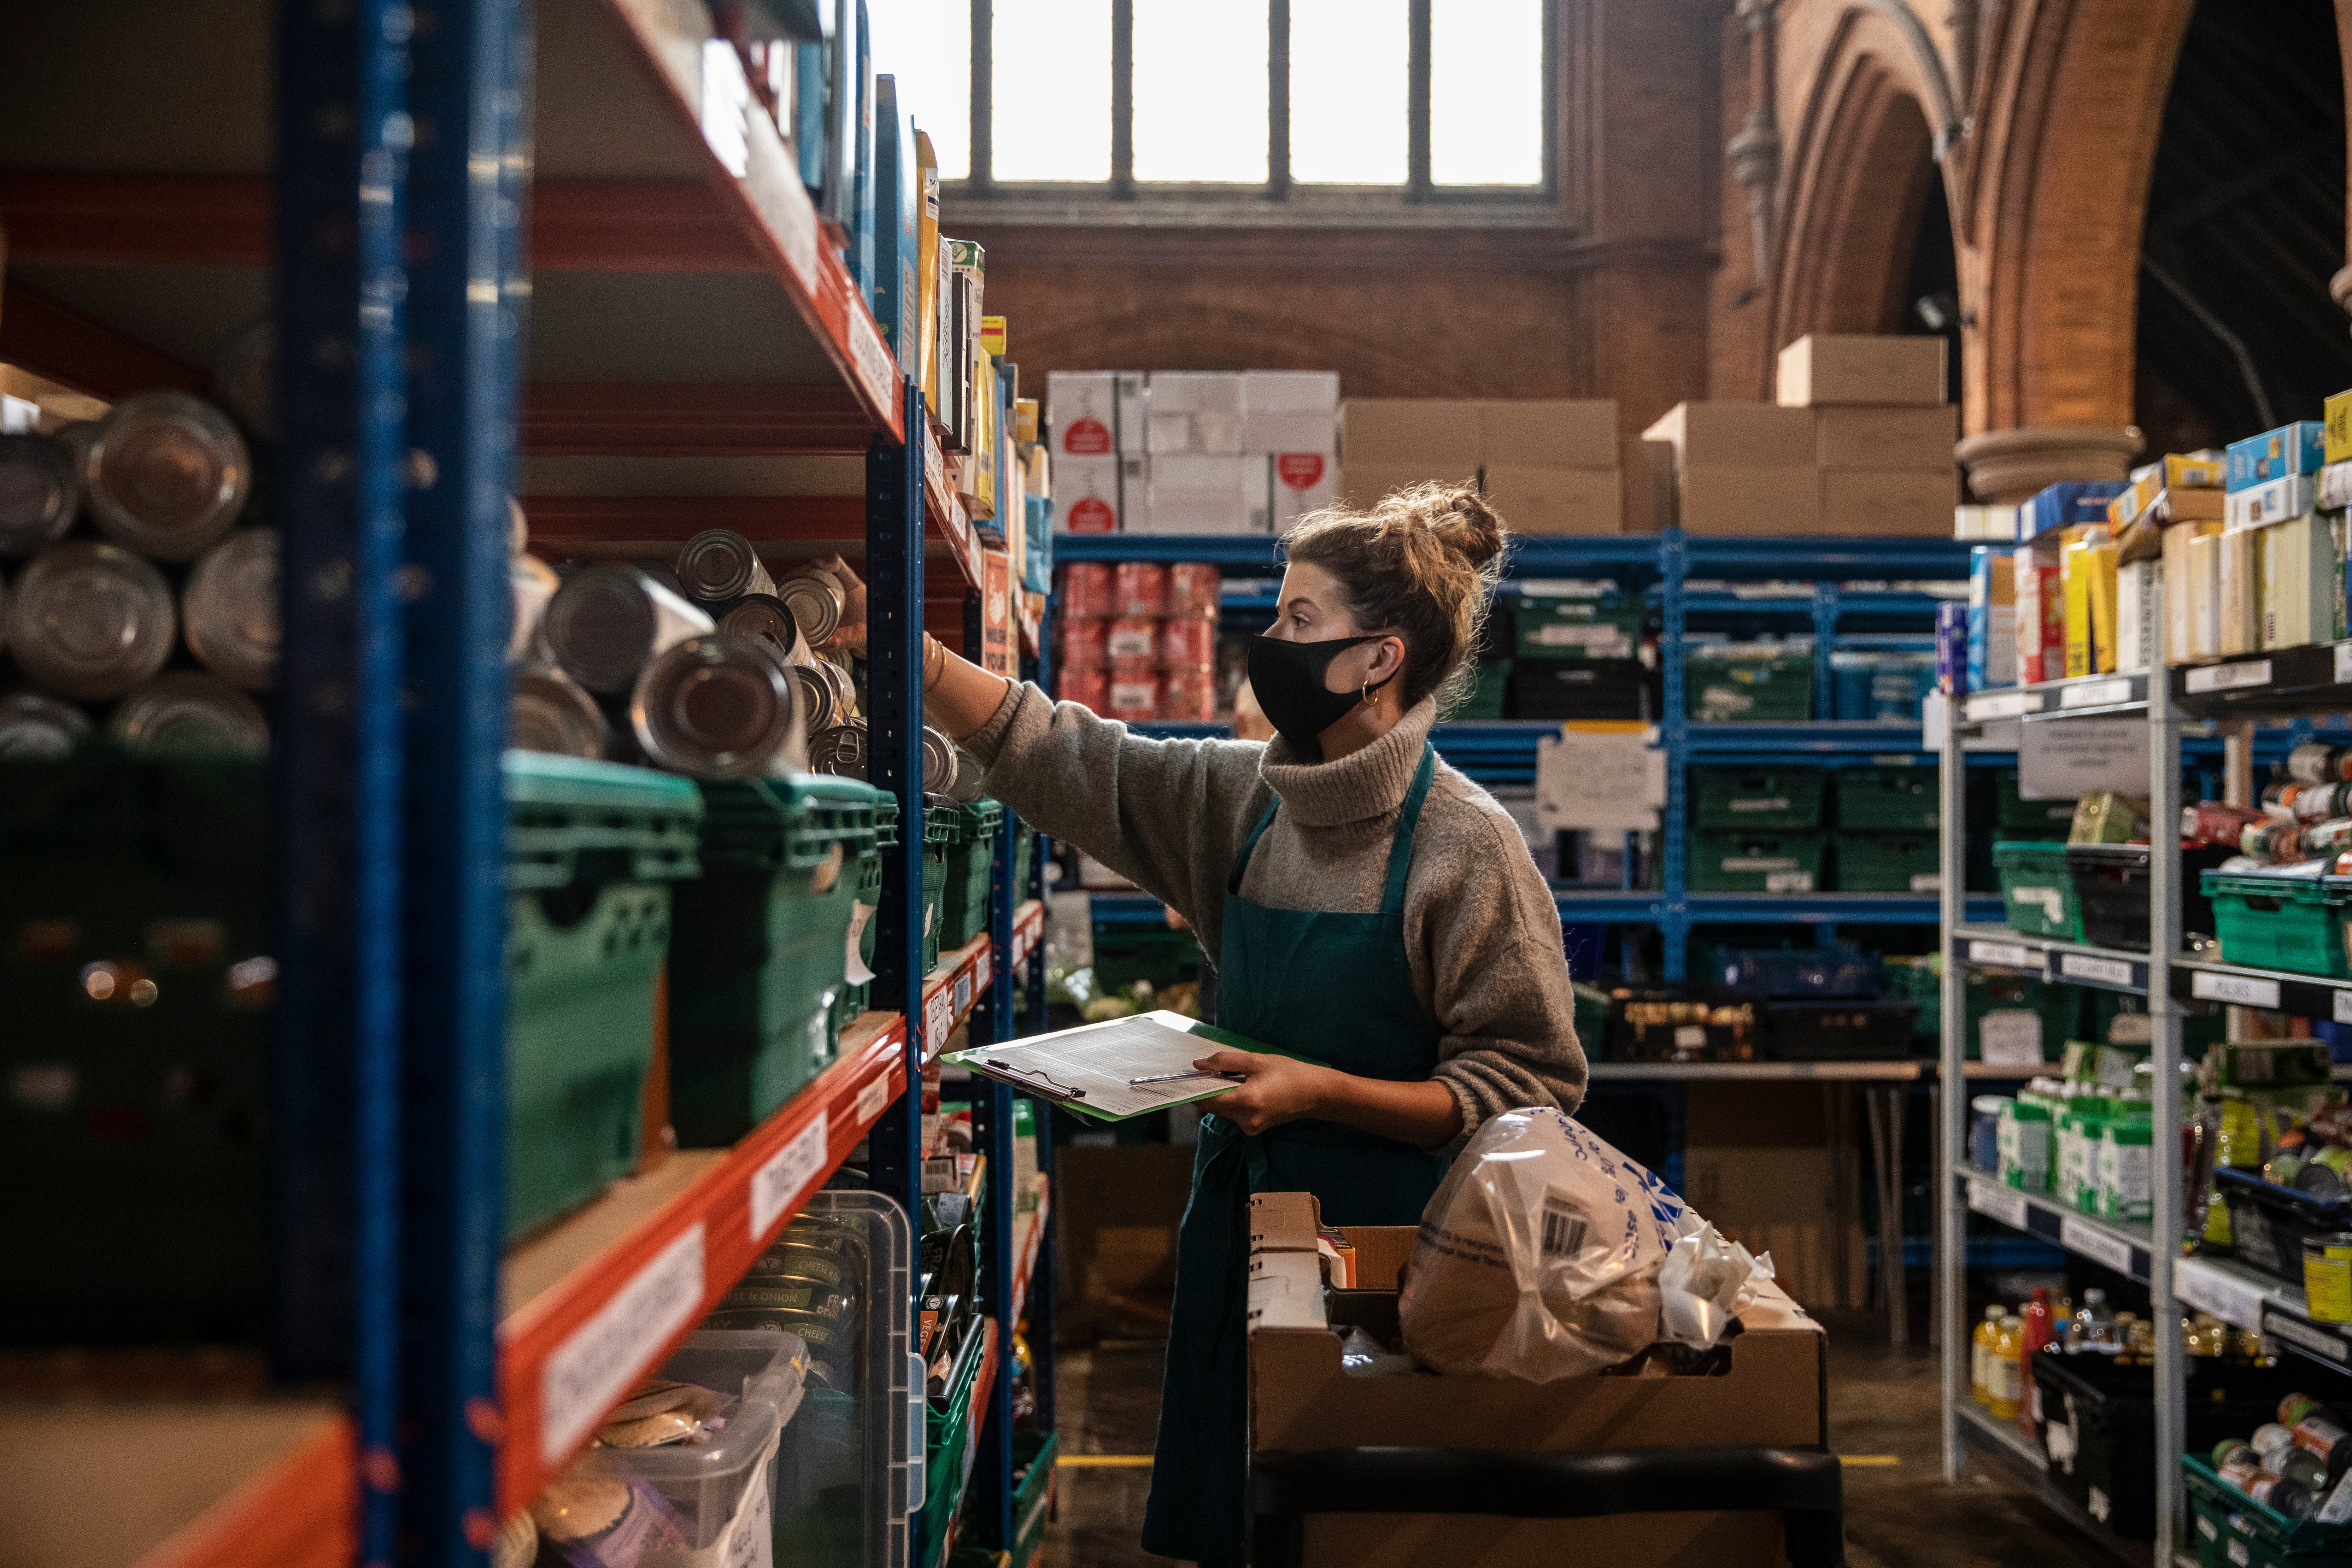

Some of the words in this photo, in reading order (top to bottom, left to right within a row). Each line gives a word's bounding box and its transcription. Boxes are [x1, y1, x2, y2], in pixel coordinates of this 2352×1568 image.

[986, 627, 1007, 645] WASH
[986, 653, 1006, 670] YOUR
[929, 990, 945, 1024] VEGETARIAN
[798, 1260, 828, 1275] CHEESE
[749, 1292, 757, 1301] &
[761, 1292, 798, 1303] ONION
